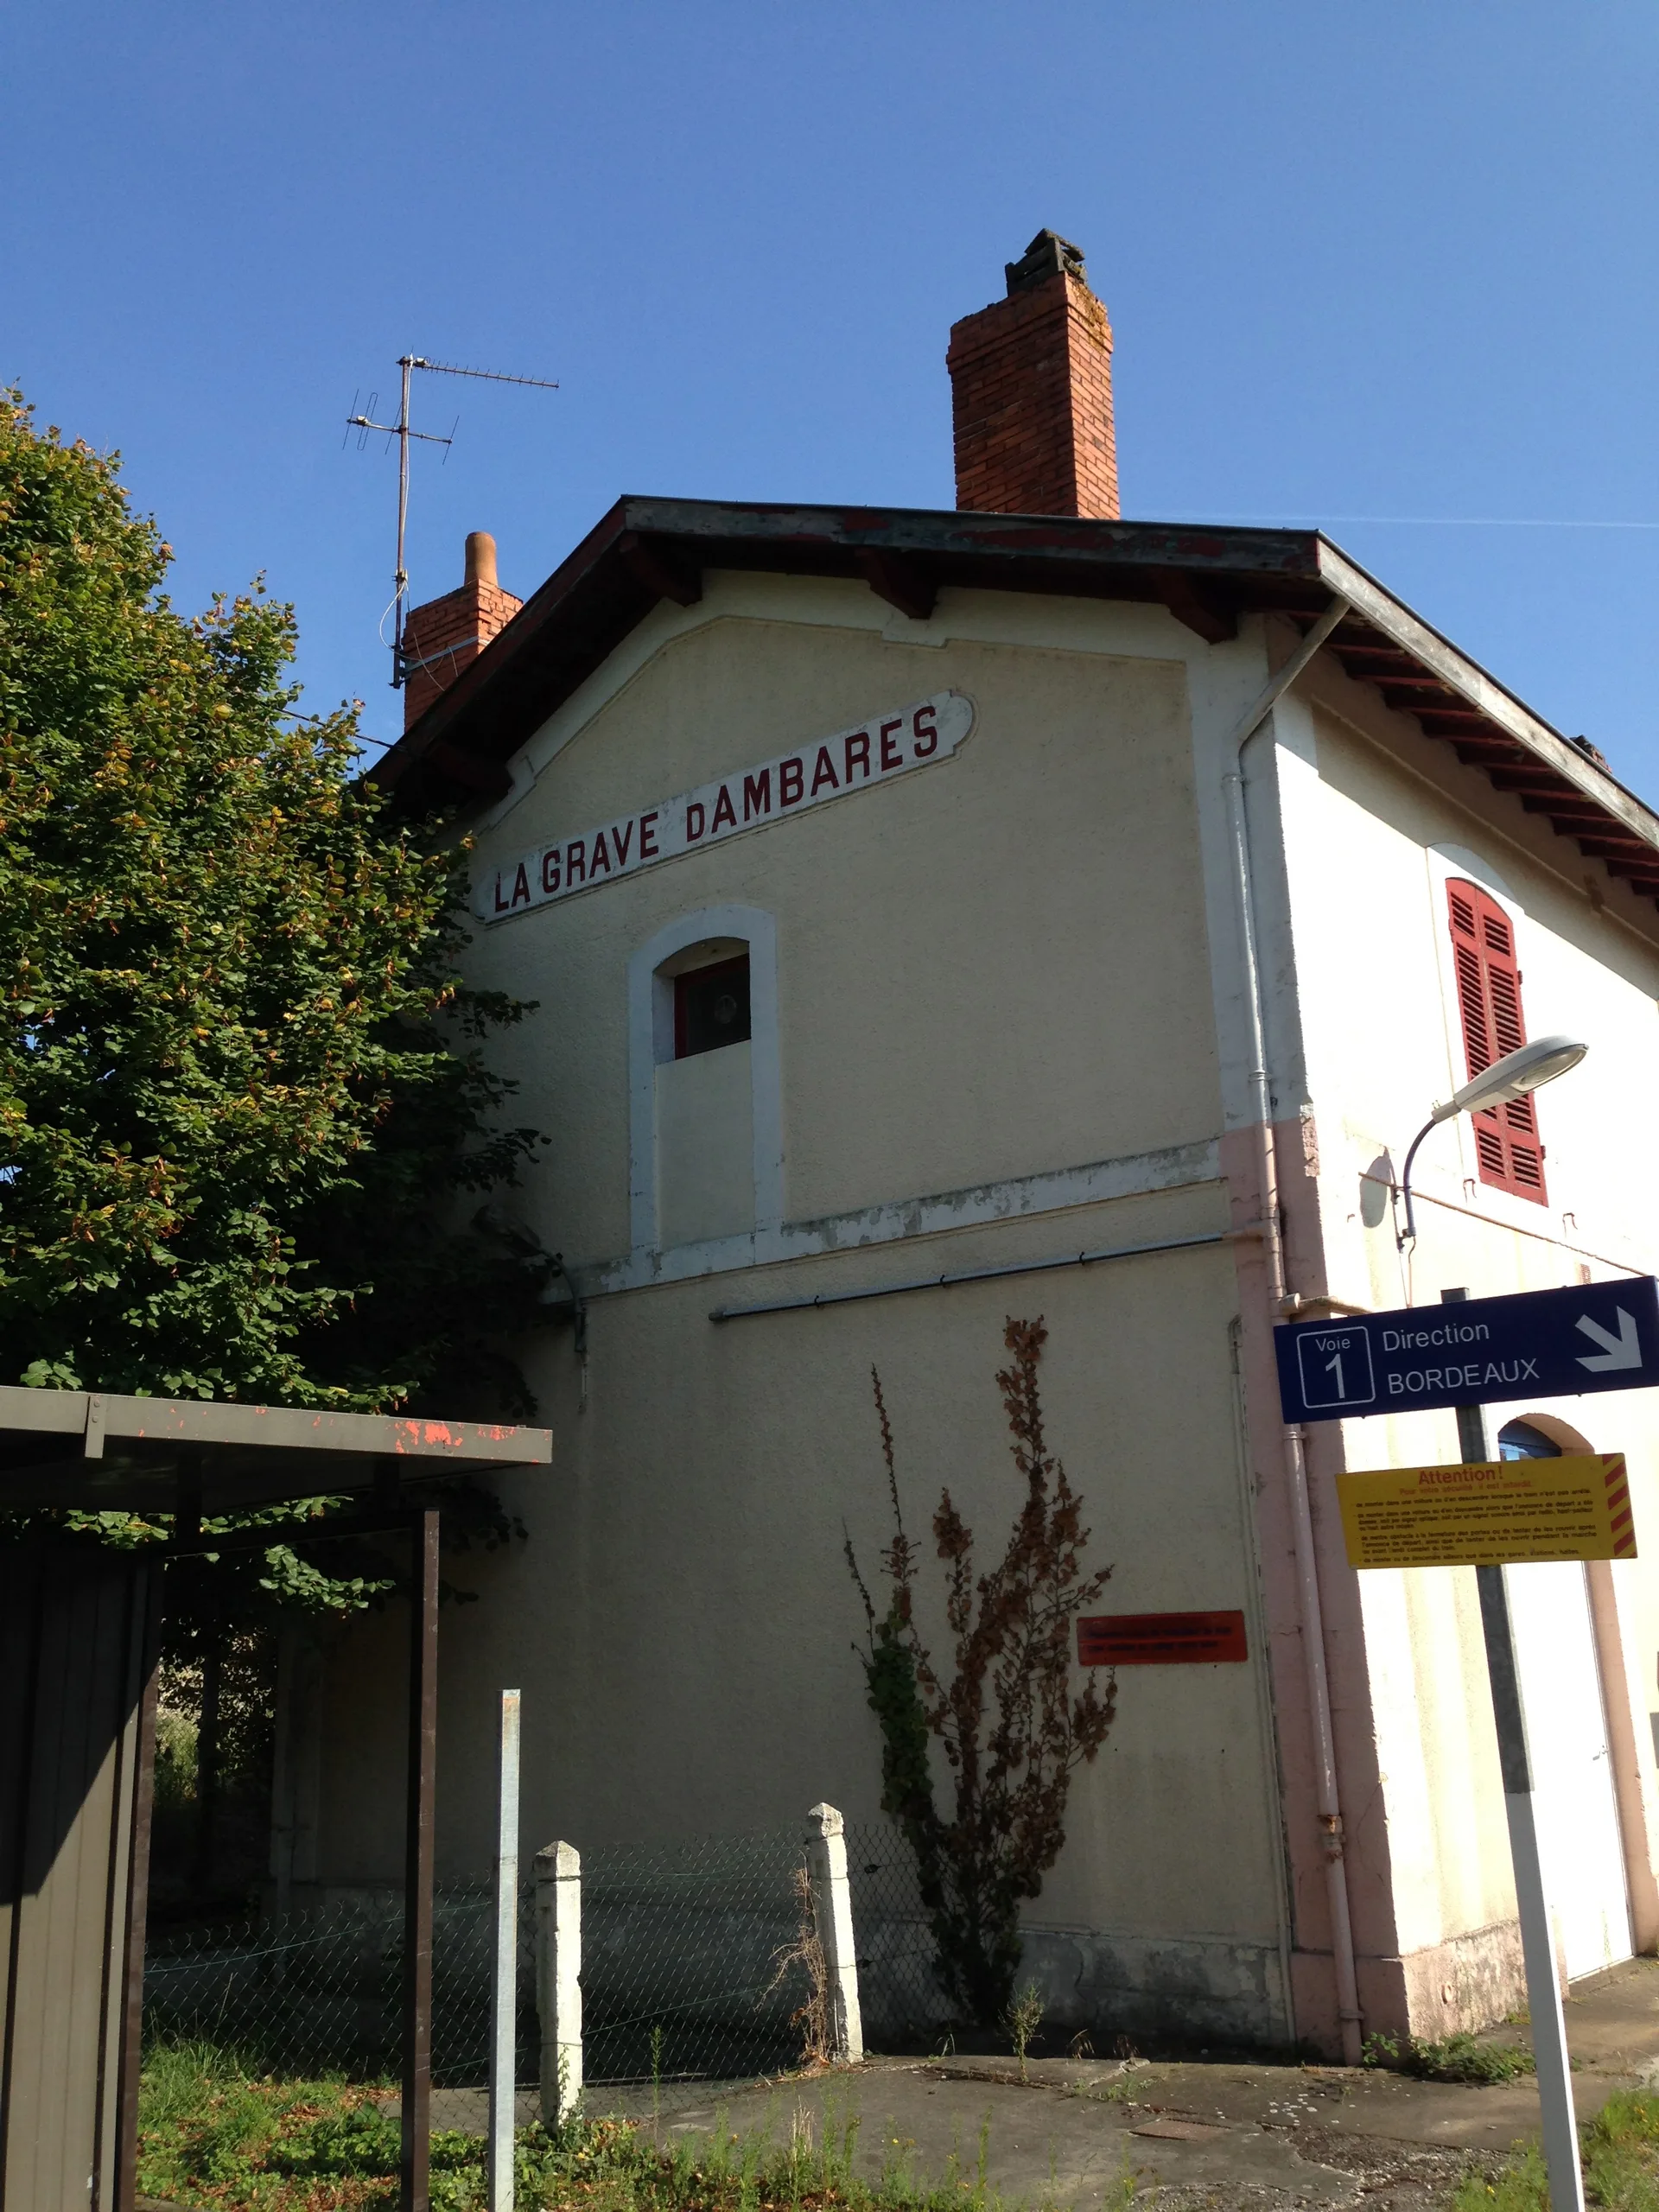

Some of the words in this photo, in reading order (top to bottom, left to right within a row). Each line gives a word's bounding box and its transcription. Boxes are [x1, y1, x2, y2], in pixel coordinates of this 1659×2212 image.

[494, 862, 531, 912] LA
[542, 811, 659, 895] GRAVE
[686, 705, 938, 842] DAMBARES
[1315, 1336, 1351, 1352] Voie
[1382, 1323, 1490, 1351] Direction
[1325, 1353, 1345, 1399] 1
[1388, 1357, 1541, 1395] BORDEAUX
